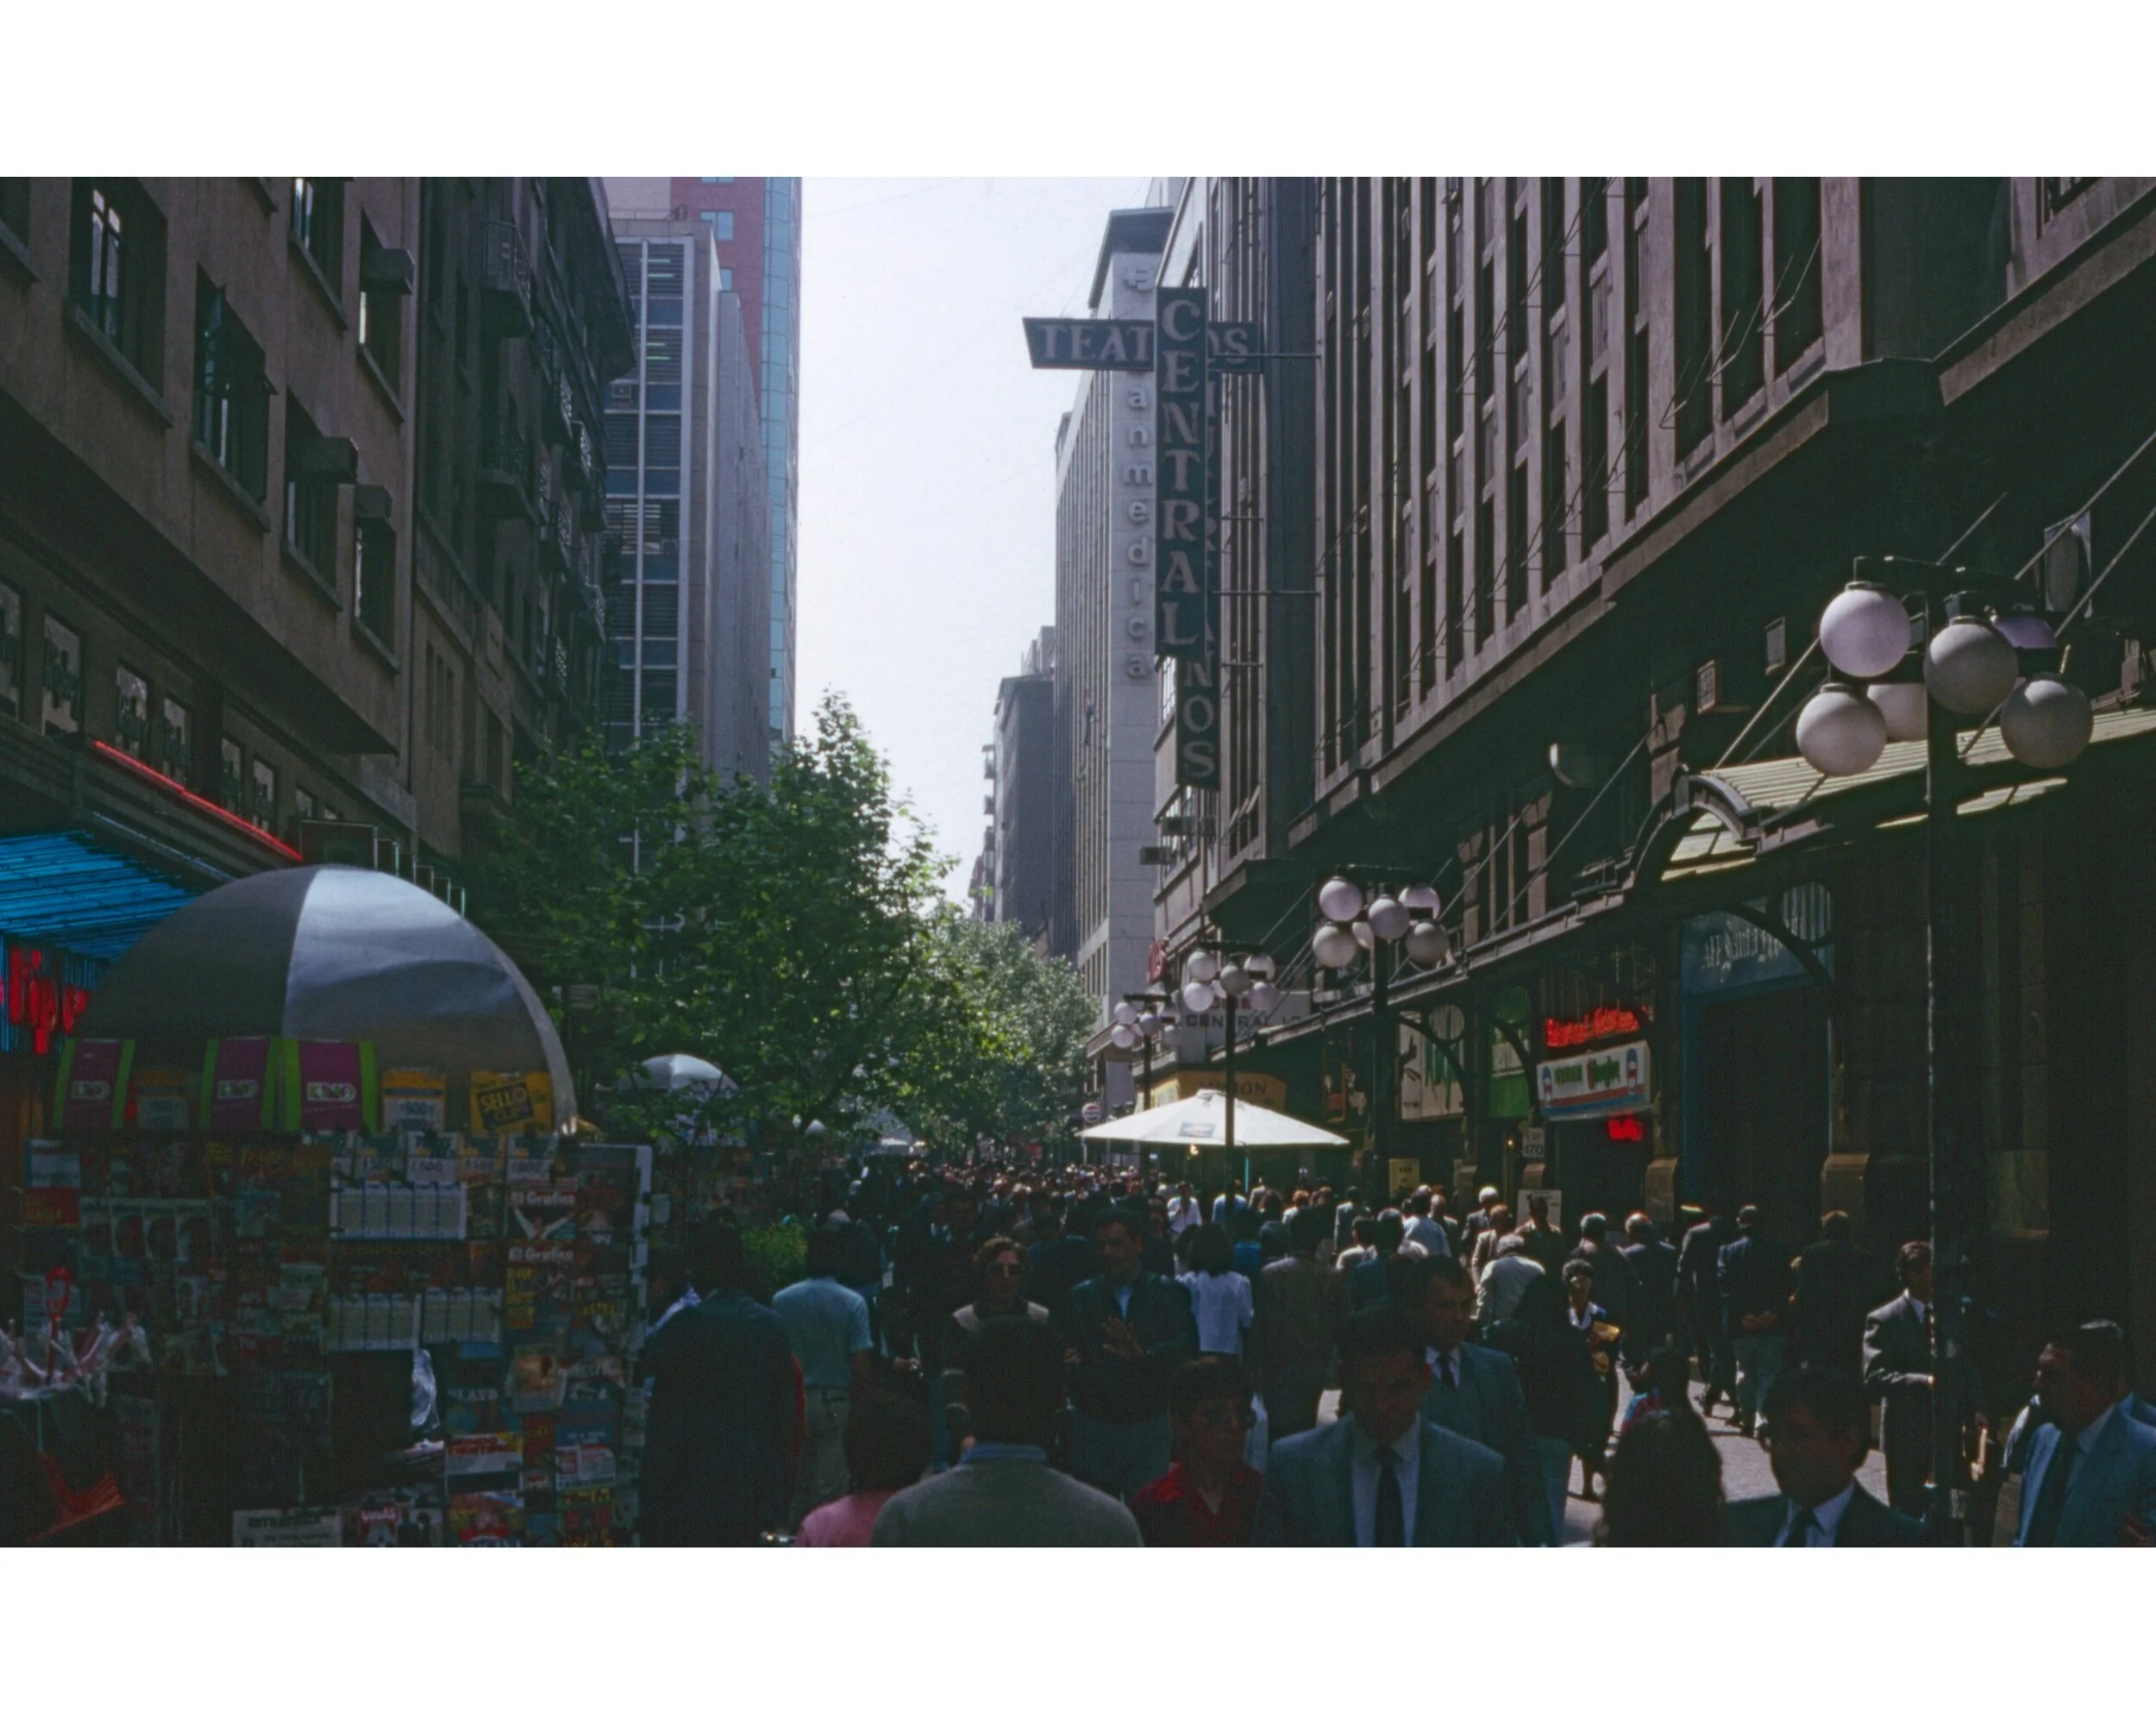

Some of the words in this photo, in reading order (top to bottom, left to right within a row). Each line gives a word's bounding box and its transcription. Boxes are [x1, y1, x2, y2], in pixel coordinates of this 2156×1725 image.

[1035, 323, 1248, 364] TEATS
[1159, 299, 1202, 646] CENTRAL
[1186, 1014, 1271, 1027] CENRAL
